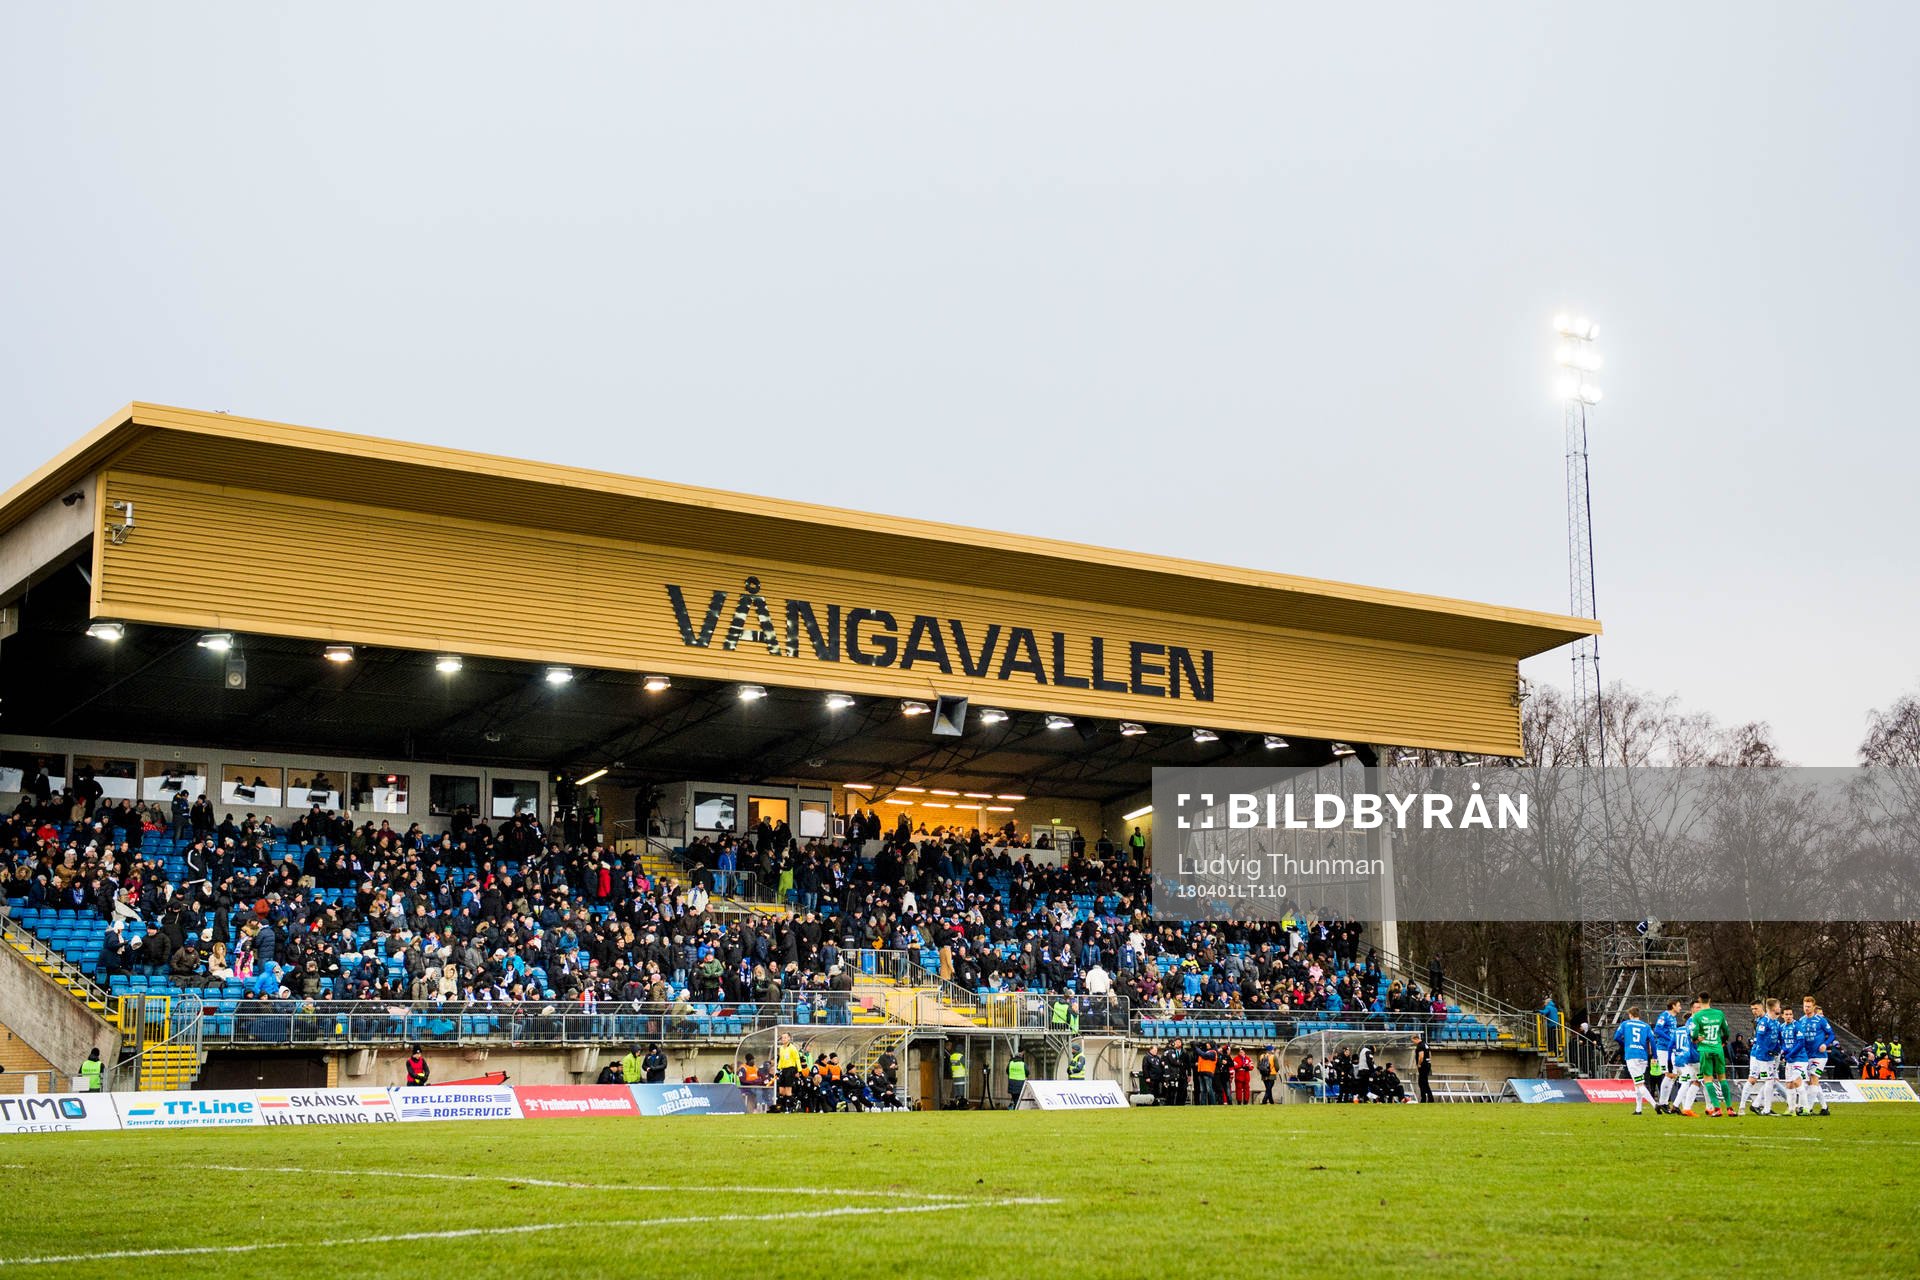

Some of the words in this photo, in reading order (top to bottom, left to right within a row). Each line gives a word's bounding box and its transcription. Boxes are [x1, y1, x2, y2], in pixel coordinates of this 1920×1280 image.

[666, 576, 1214, 702] VÅNGAVALLEN
[1632, 1027, 1641, 1043] 5
[1702, 1024, 1720, 1041] 30
[290, 1091, 360, 1107] SKÅNSK
[402, 1094, 493, 1104] TRELLEBORGS
[1056, 1091, 1120, 1105] Tillmobil
[163, 1099, 254, 1115] TT-Line
[374, 1111, 397, 1123] AB
